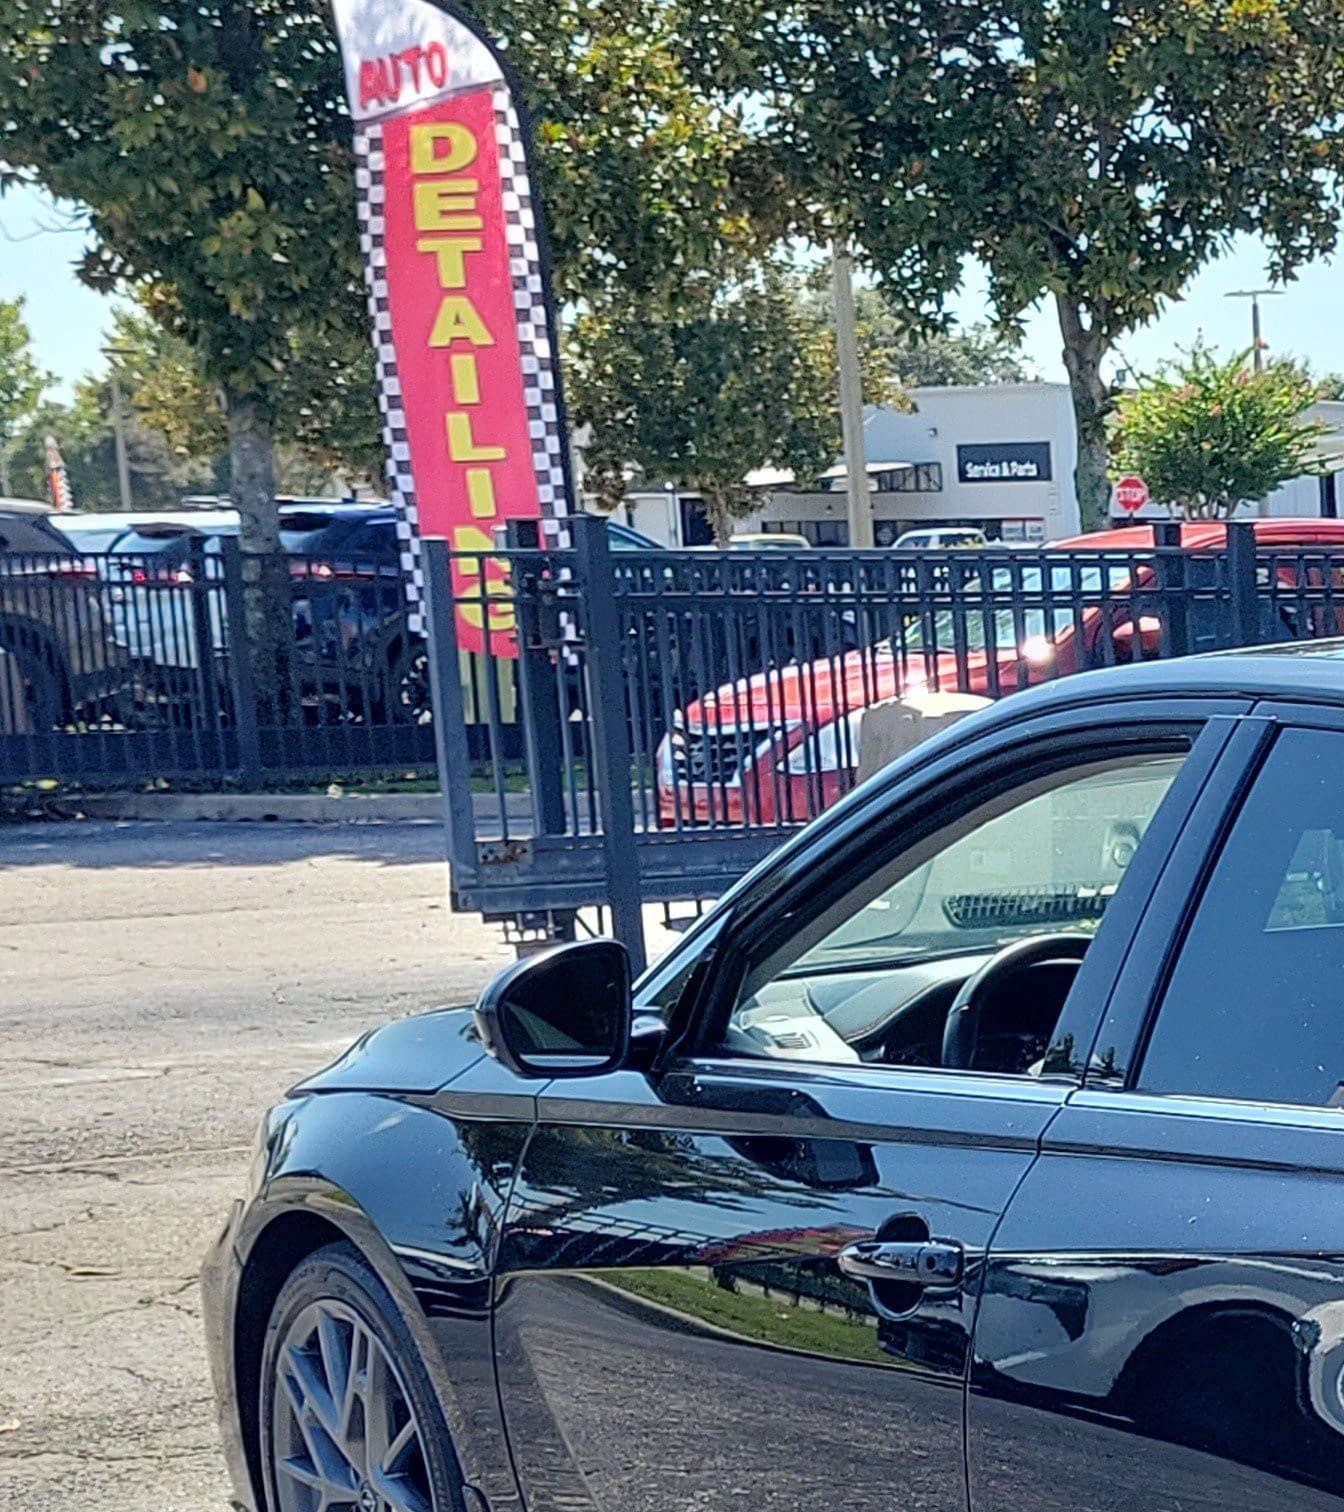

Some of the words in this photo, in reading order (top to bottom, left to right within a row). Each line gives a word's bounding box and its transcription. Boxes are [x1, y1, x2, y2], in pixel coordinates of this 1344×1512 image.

[358, 41, 449, 110] AUTO
[965, 461, 1000, 478] Service
[1010, 459, 1038, 476] Parts
